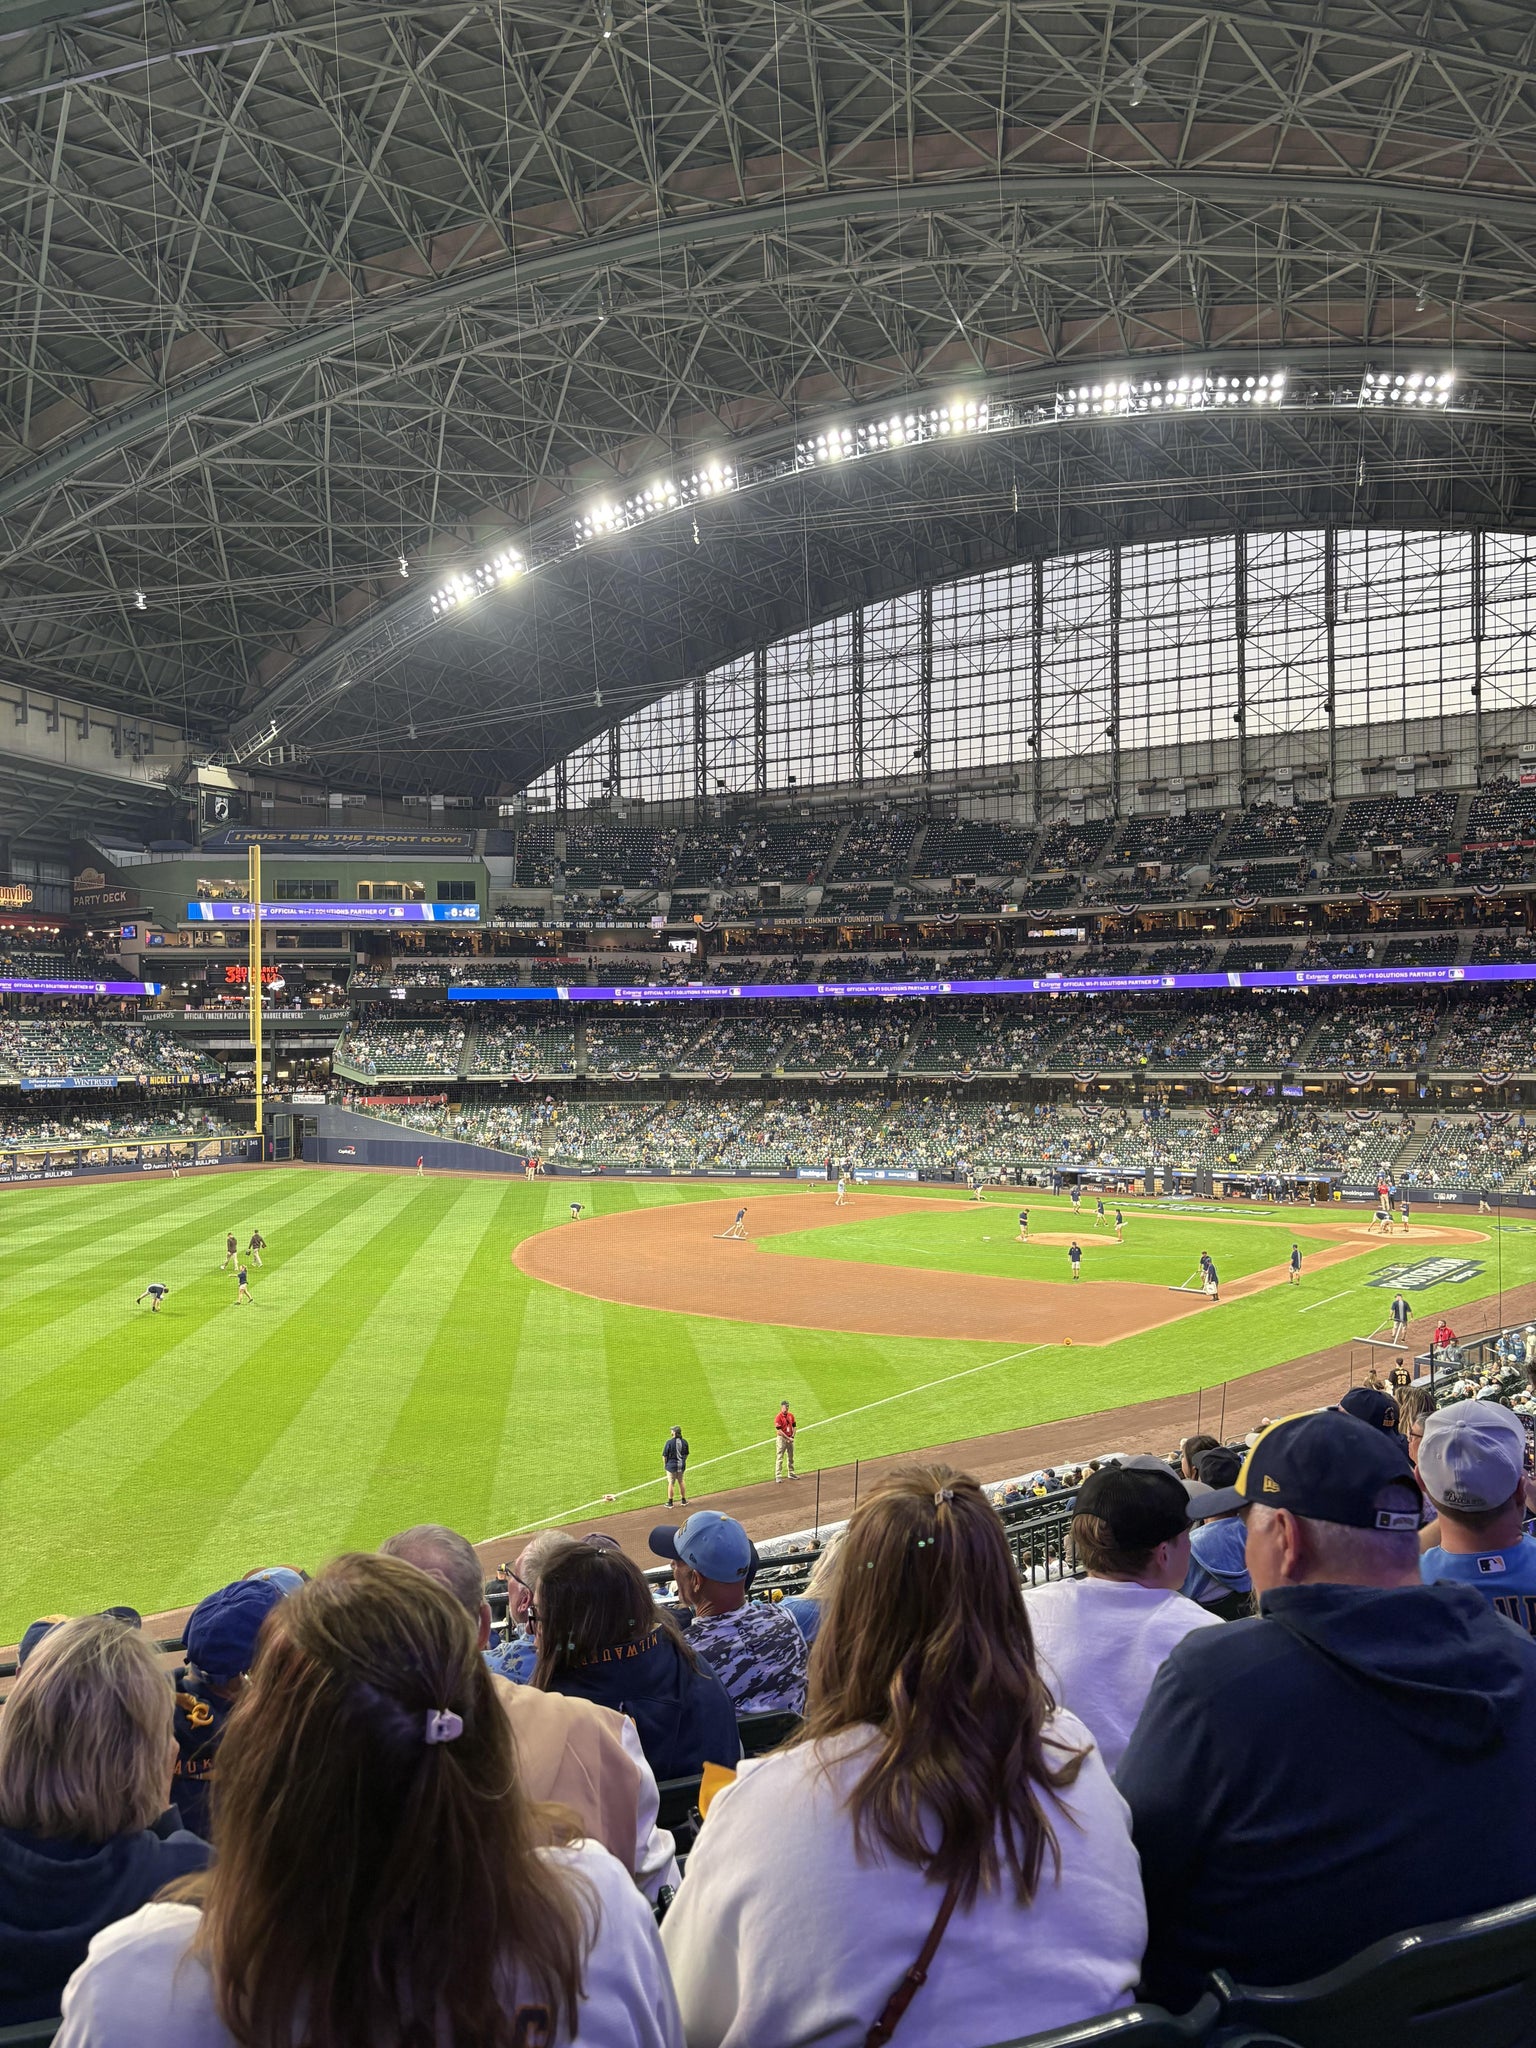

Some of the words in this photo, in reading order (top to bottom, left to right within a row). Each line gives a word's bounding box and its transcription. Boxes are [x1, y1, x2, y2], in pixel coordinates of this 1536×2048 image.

[73, 894, 101, 906] PARTY
[103, 891, 126, 903] DECK
[844, 915, 884, 923] FOUNDATION
[184, 1012, 204, 1020] OFFICIAL
[205, 1012, 223, 1020] FROZEN
[73, 1078, 113, 1086] WINTRUST
[149, 1076, 175, 1085] NICOLET
[176, 1075, 190, 1084] LAW
[11, 1173, 28, 1181] Health
[44, 1170, 73, 1178] BULLPEN
